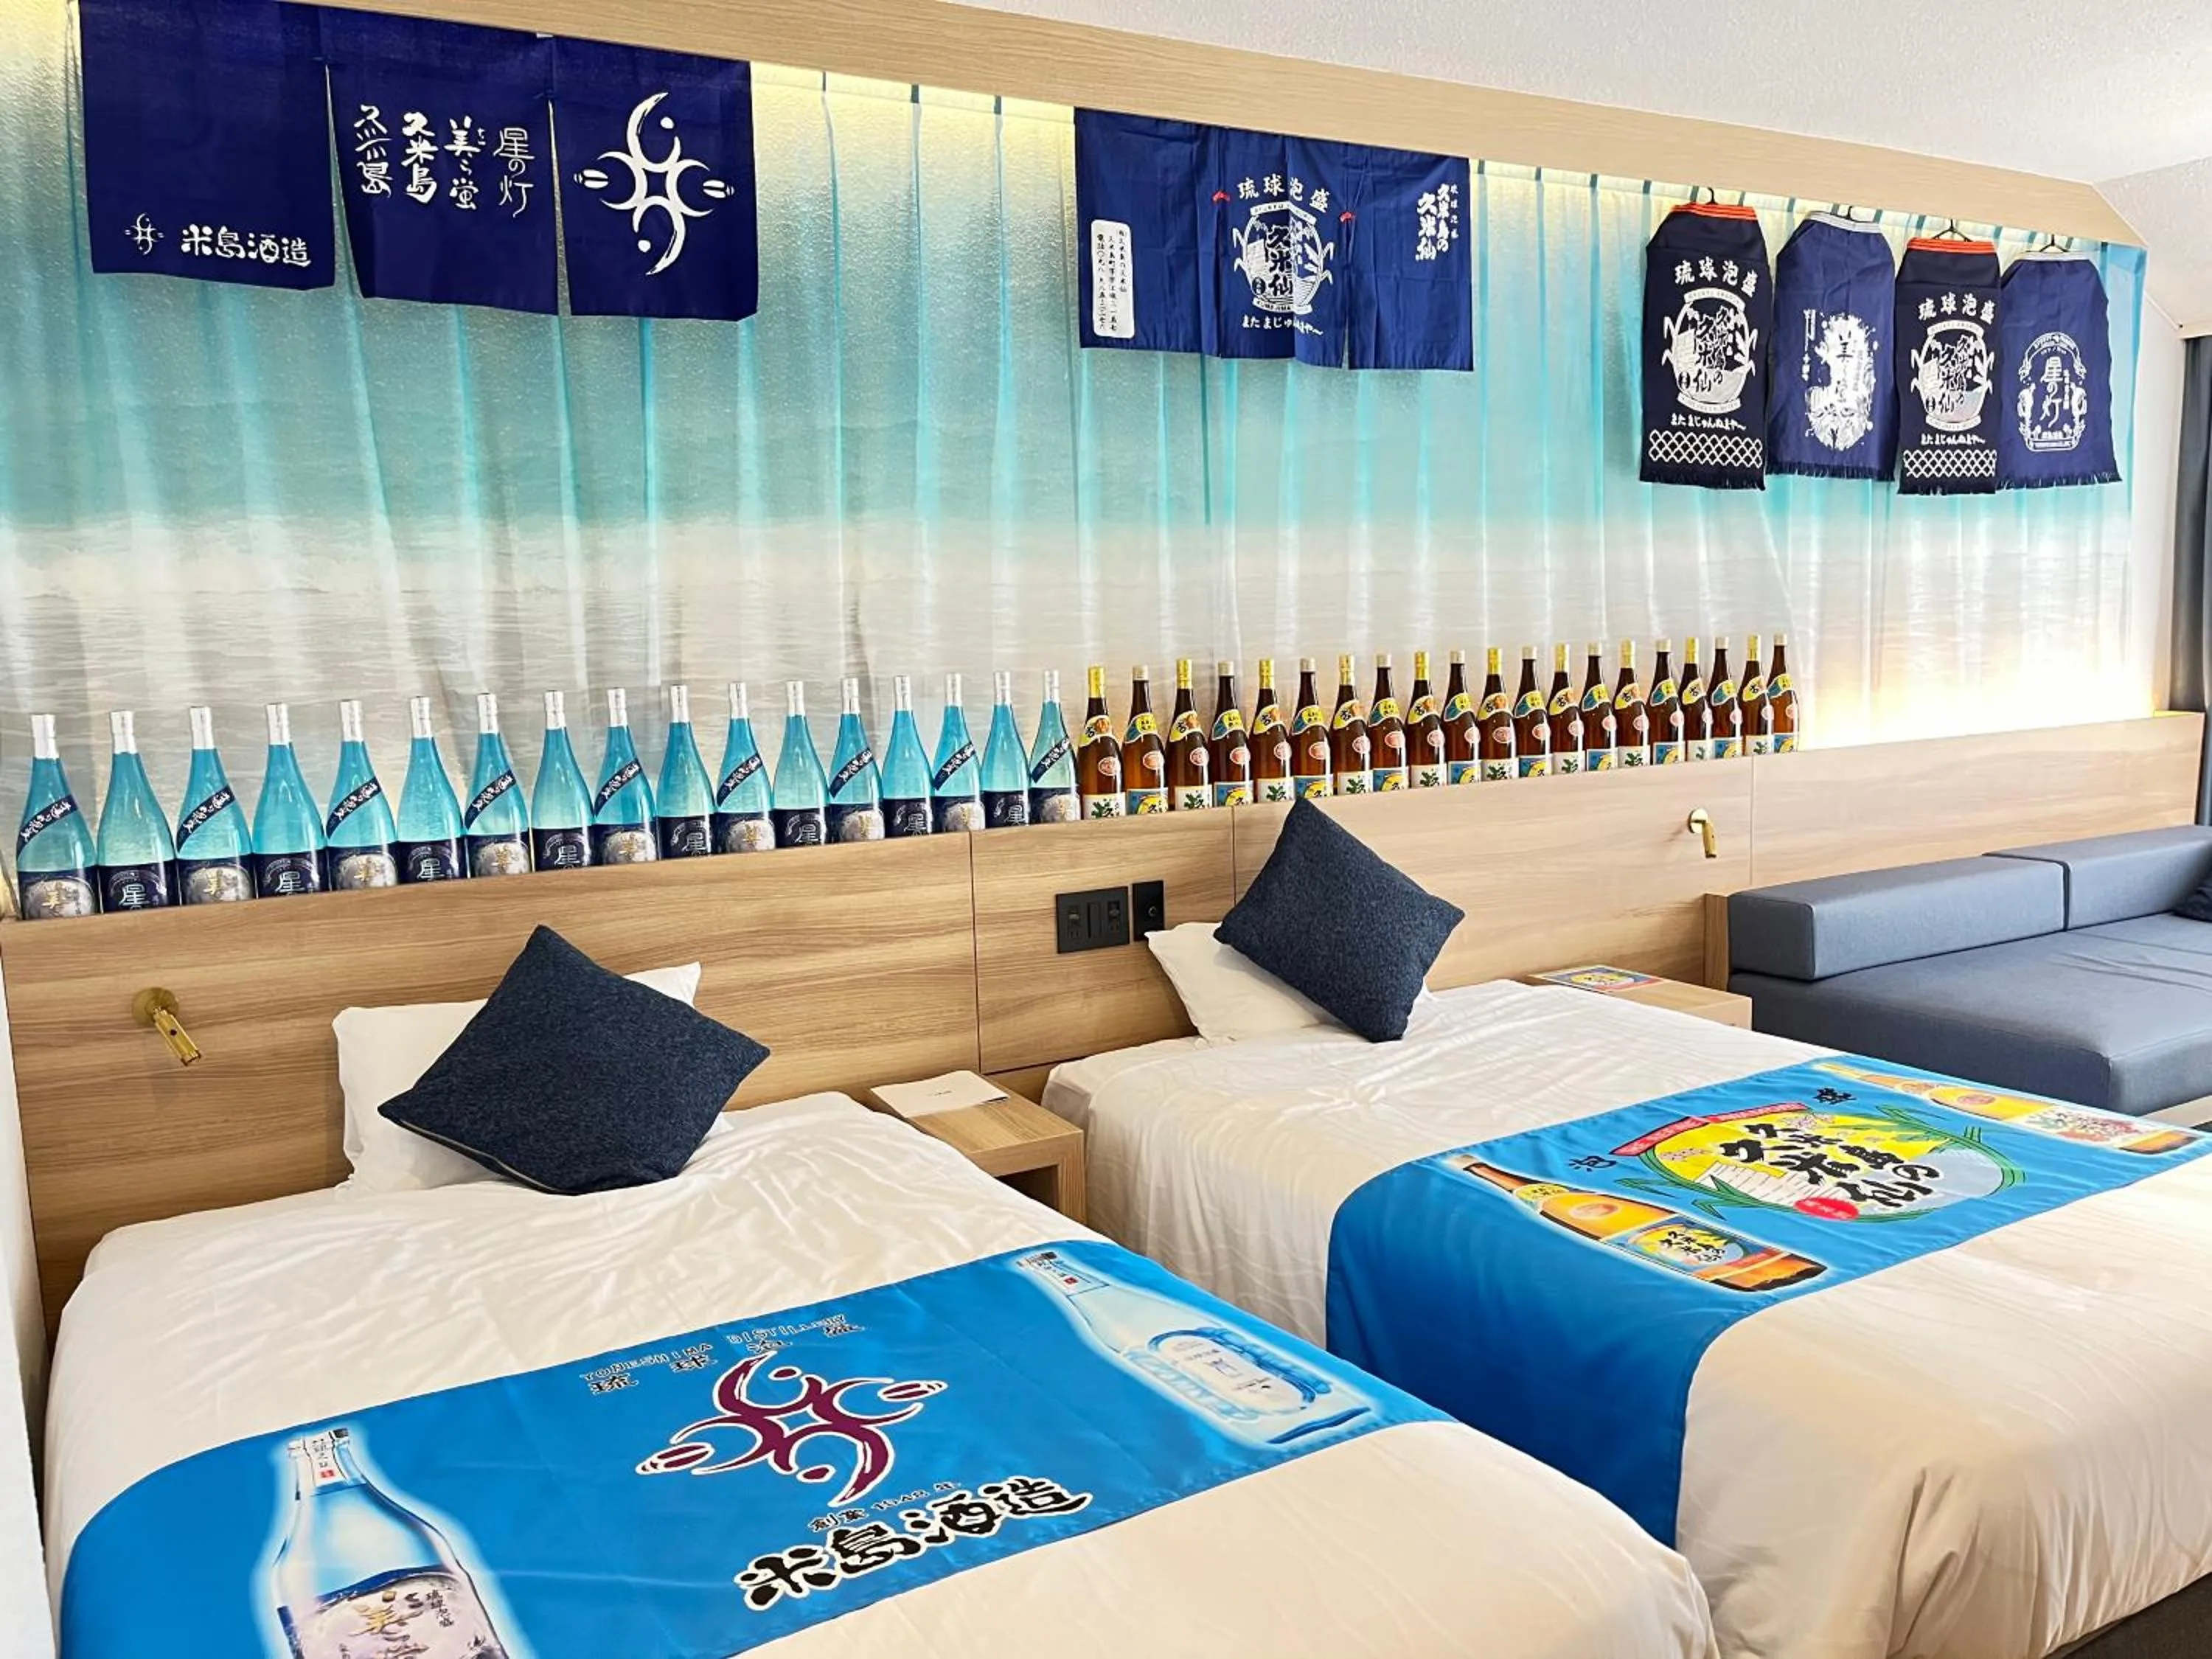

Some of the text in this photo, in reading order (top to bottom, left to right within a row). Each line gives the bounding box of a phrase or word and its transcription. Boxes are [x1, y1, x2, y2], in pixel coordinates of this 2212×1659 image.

[402, 112, 439, 204] 久米島
[493, 128, 535, 218] 星の灯
[1237, 173, 1330, 213] 琉球泡盛
[181, 223, 312, 268] 米島酒造
[2040, 356, 2063, 428] 星の灯
[1719, 1140, 1933, 1208] 久米仙
[1743, 1122, 1941, 1181] 久米島の
[737, 1477, 1090, 1609] 米島酒造
